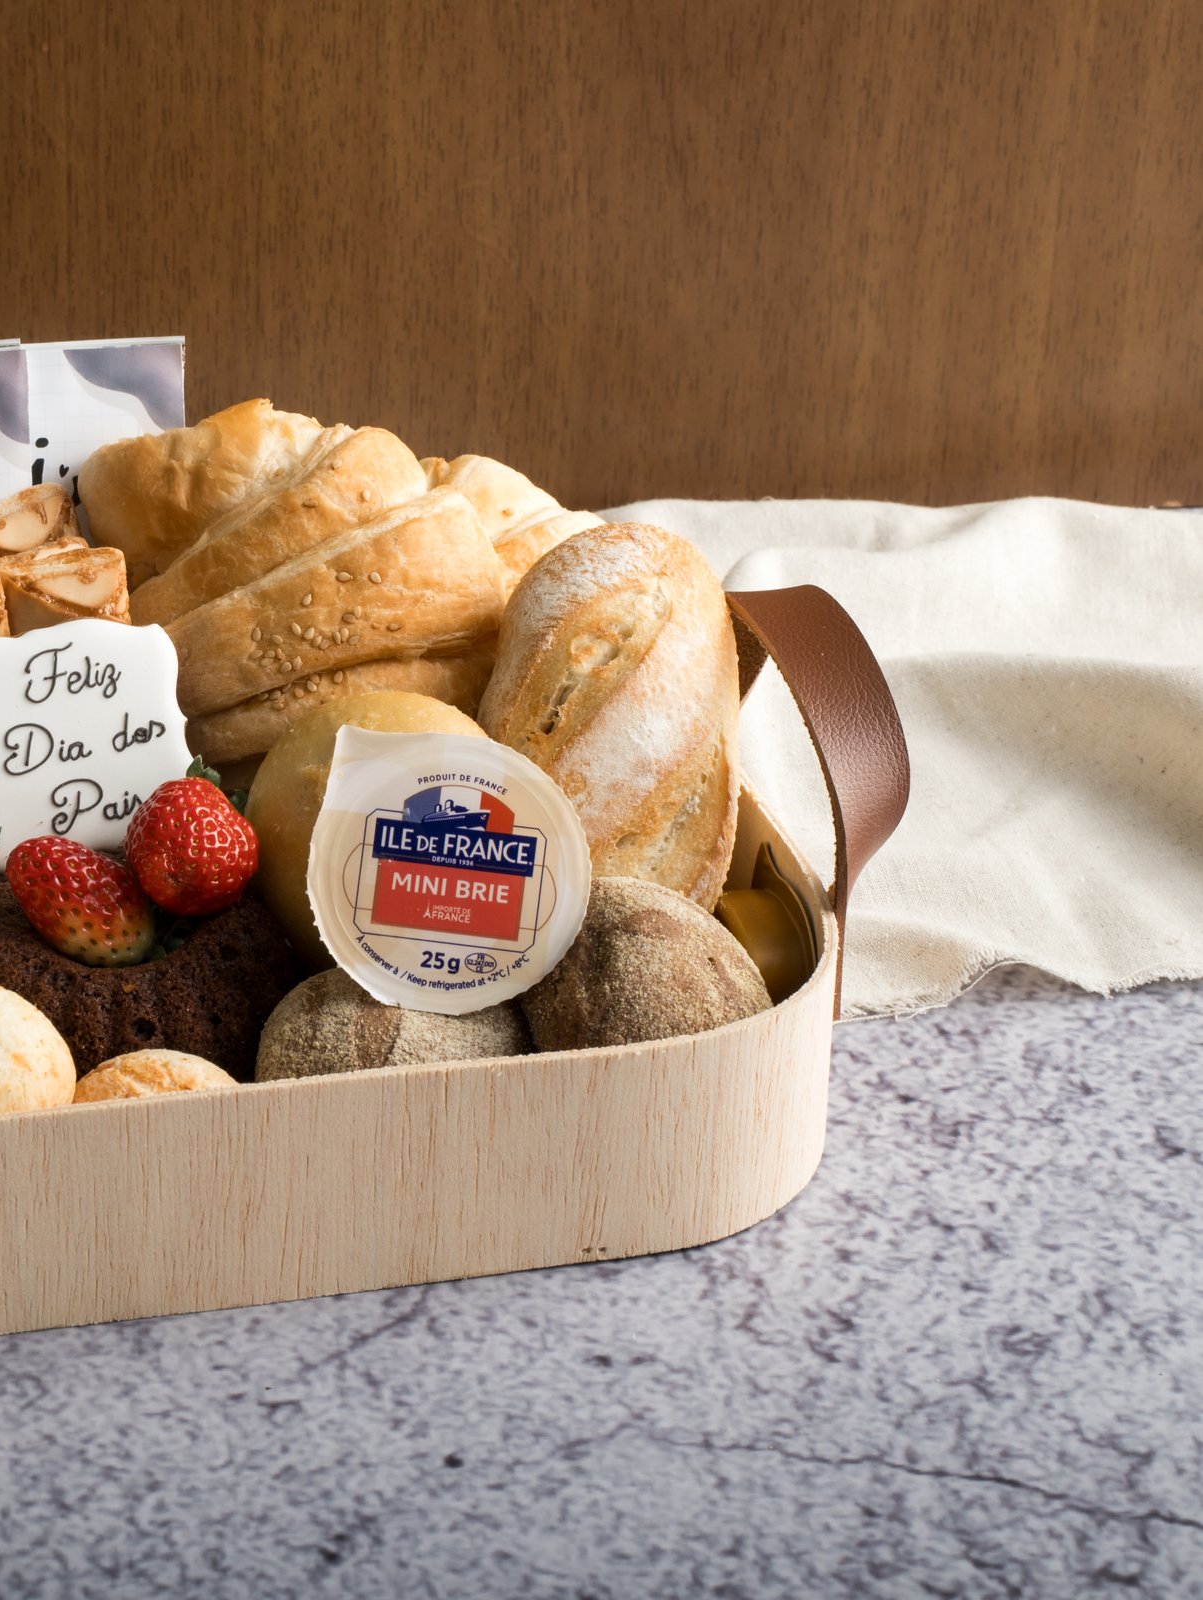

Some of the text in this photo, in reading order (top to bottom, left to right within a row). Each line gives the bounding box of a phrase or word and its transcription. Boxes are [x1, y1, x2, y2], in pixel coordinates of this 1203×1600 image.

[24, 641, 122, 703] Feliz
[3, 712, 166, 776] Dia dos
[417, 773, 508, 796] PRODUIT DE FRANCE
[380, 825, 531, 865] ILE DE FRANCE
[431, 855, 474, 867] DEPUIS 1936
[391, 872, 509, 904] MINI BRIE
[432, 905, 462, 914] IMPORTÉ
[432, 911, 471, 923] FRANCE
[361, 942, 394, 971] conserver
[407, 973, 427, 987] Keep
[428, 979, 476, 991] refrigerated
[477, 977, 486, 986] at
